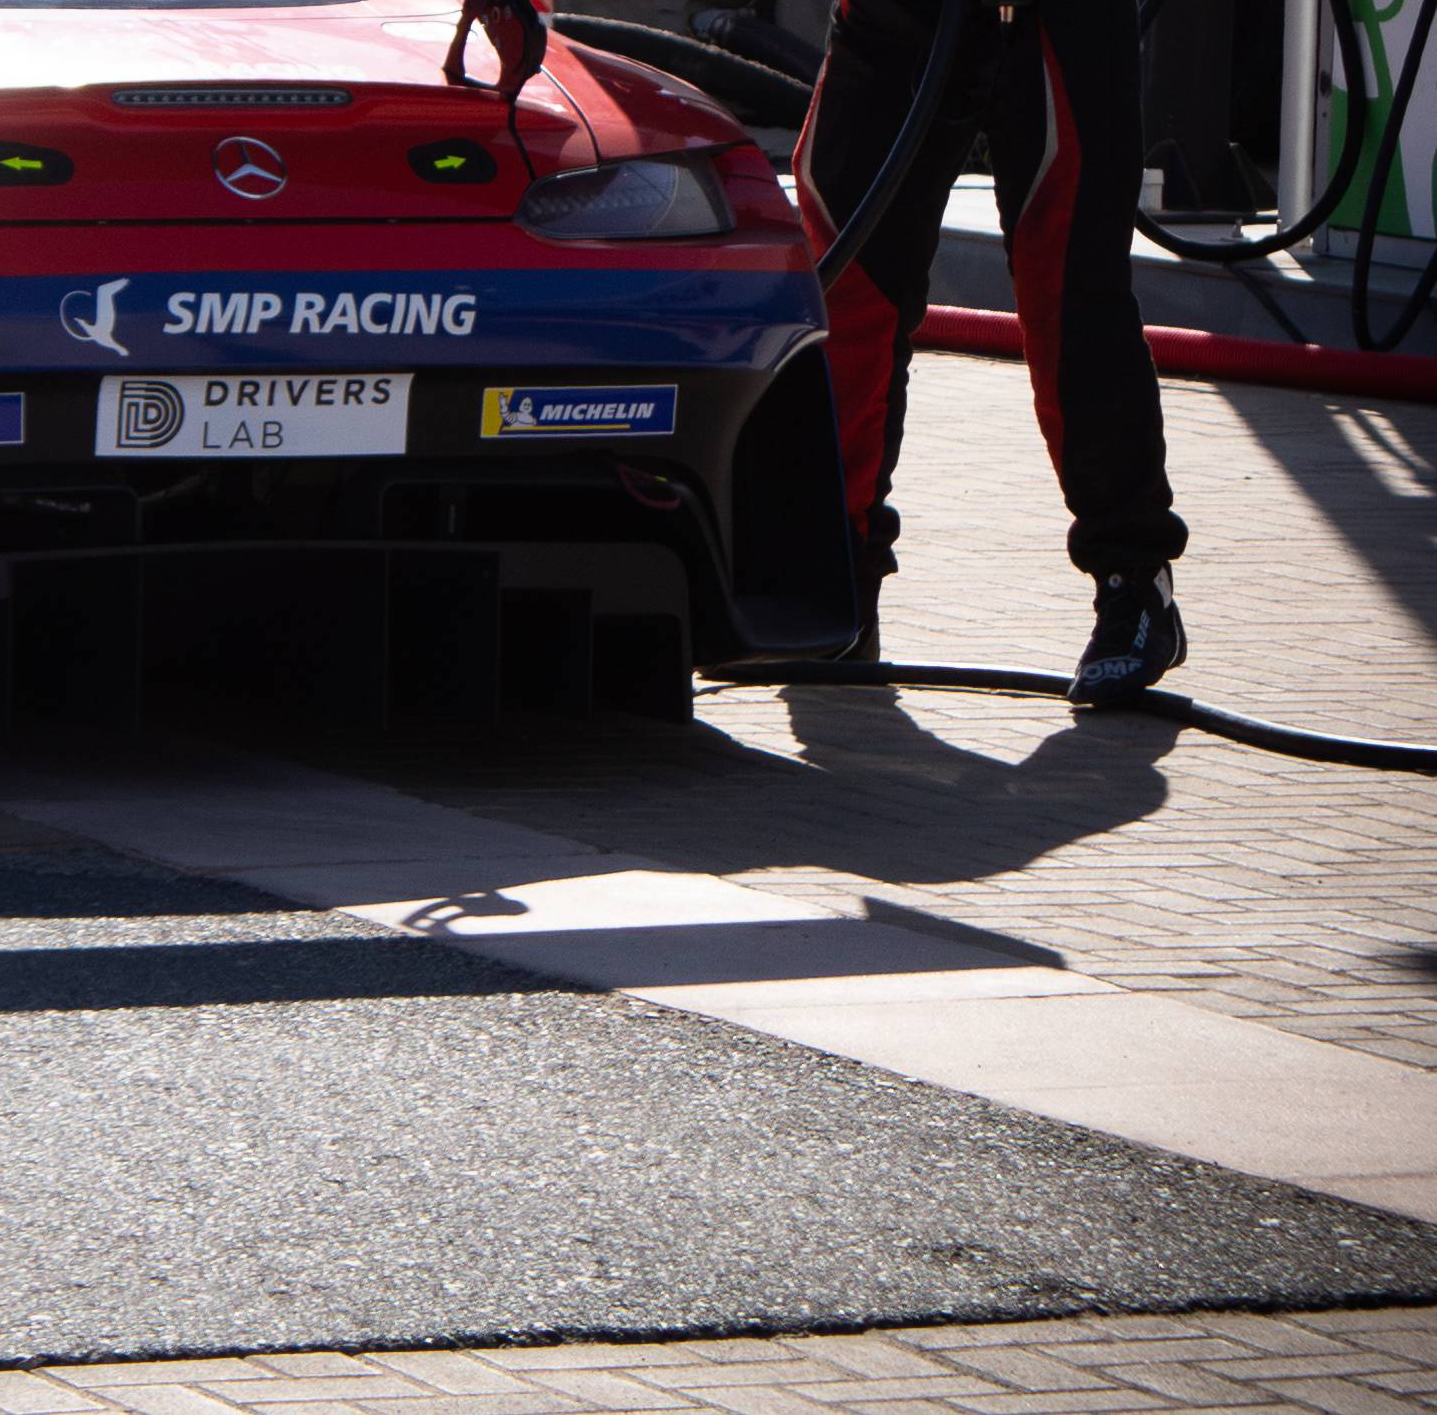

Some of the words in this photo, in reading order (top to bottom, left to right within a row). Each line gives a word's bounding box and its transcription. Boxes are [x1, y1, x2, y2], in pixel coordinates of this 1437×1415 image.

[163, 291, 282, 335] SMP
[289, 292, 476, 336] RACING
[203, 377, 392, 408] DRIVERS
[539, 402, 656, 421] MICHELIN
[202, 419, 284, 451] LAB
